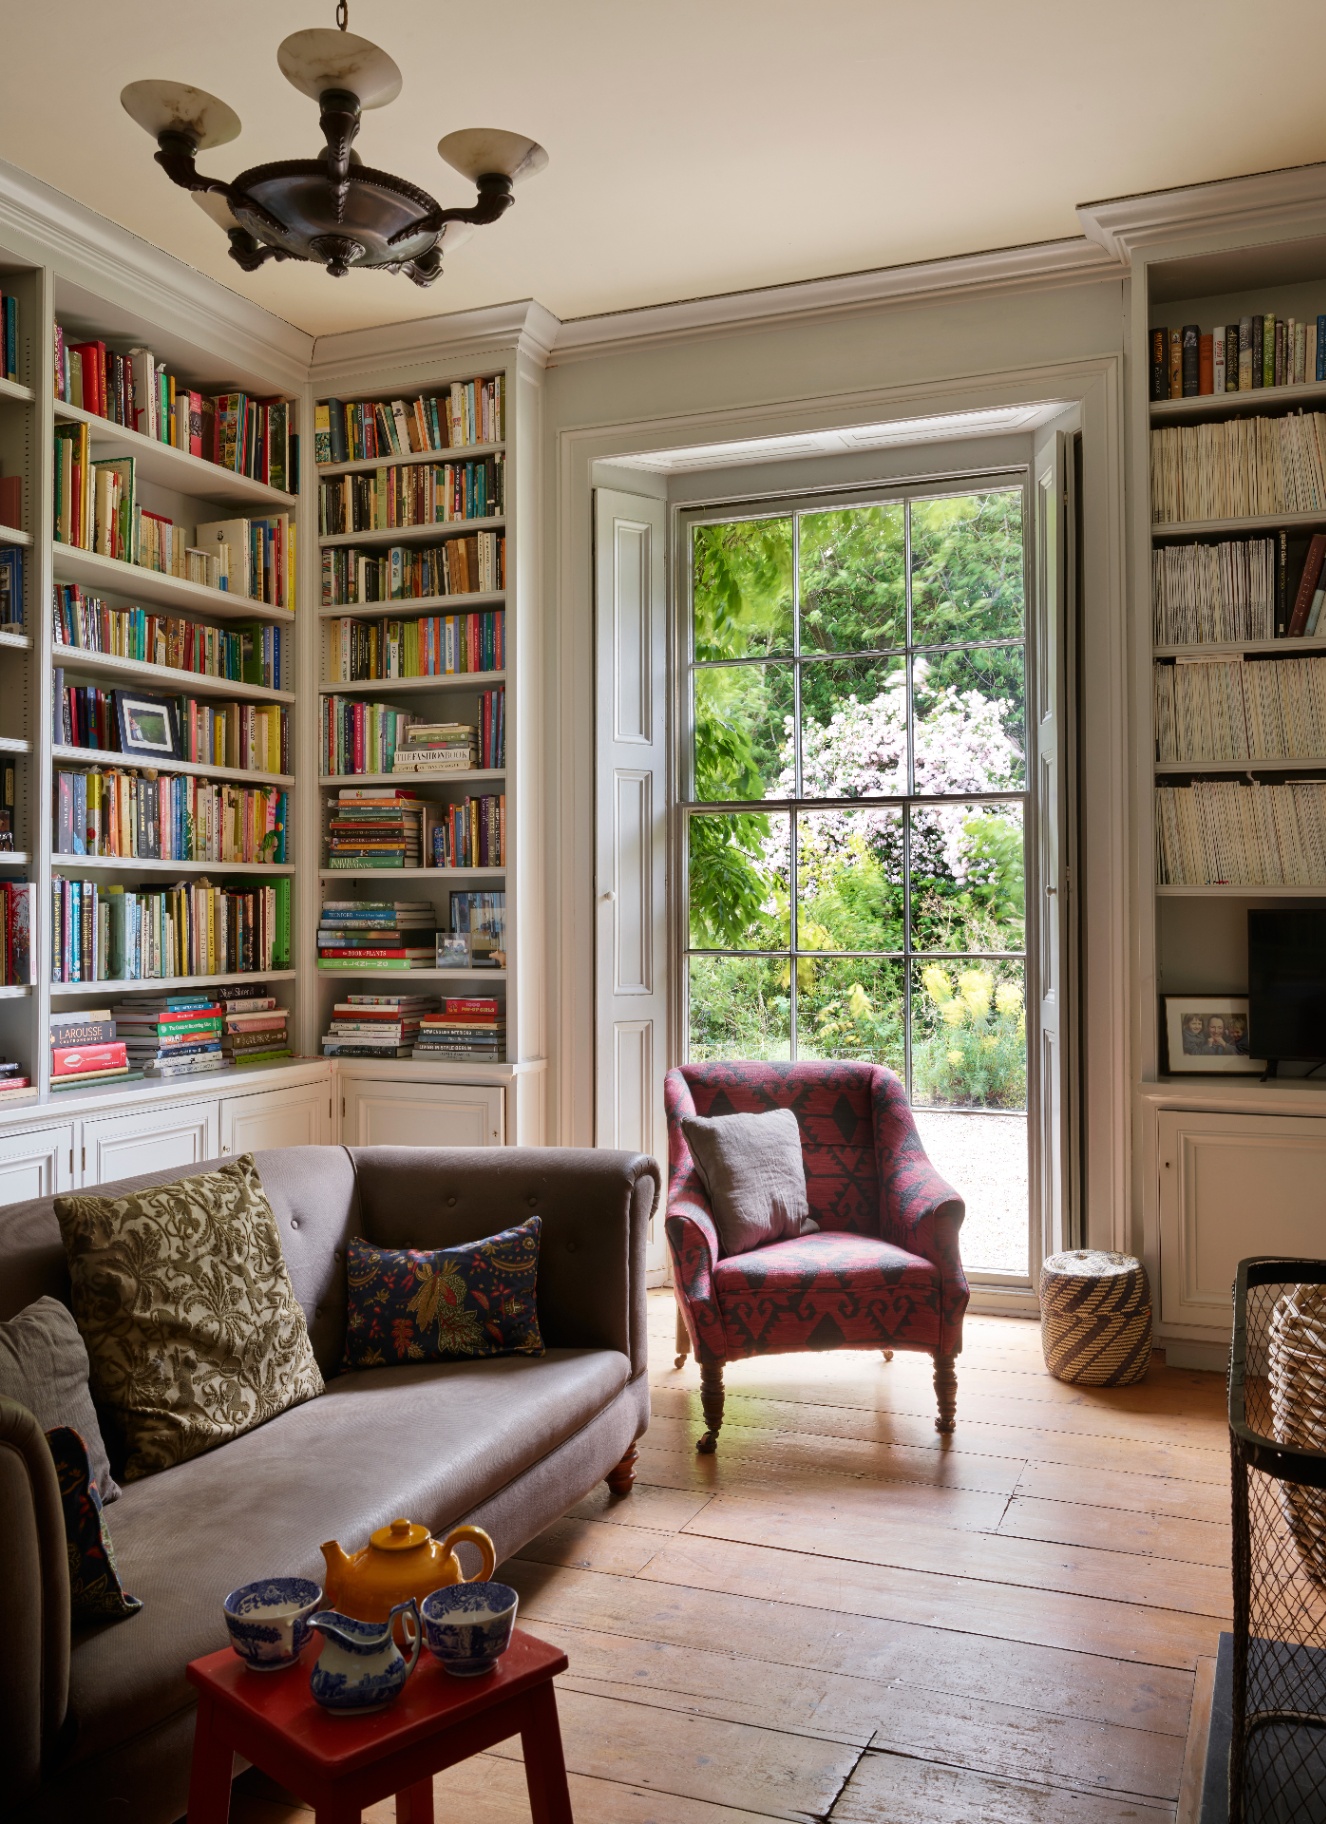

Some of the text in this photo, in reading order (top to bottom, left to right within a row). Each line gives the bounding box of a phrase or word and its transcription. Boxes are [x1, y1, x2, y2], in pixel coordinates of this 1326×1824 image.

[412, 751, 445, 761] FASHION
[445, 750, 467, 760] BOOK
[60, 1026, 103, 1040] LAROUSSE
